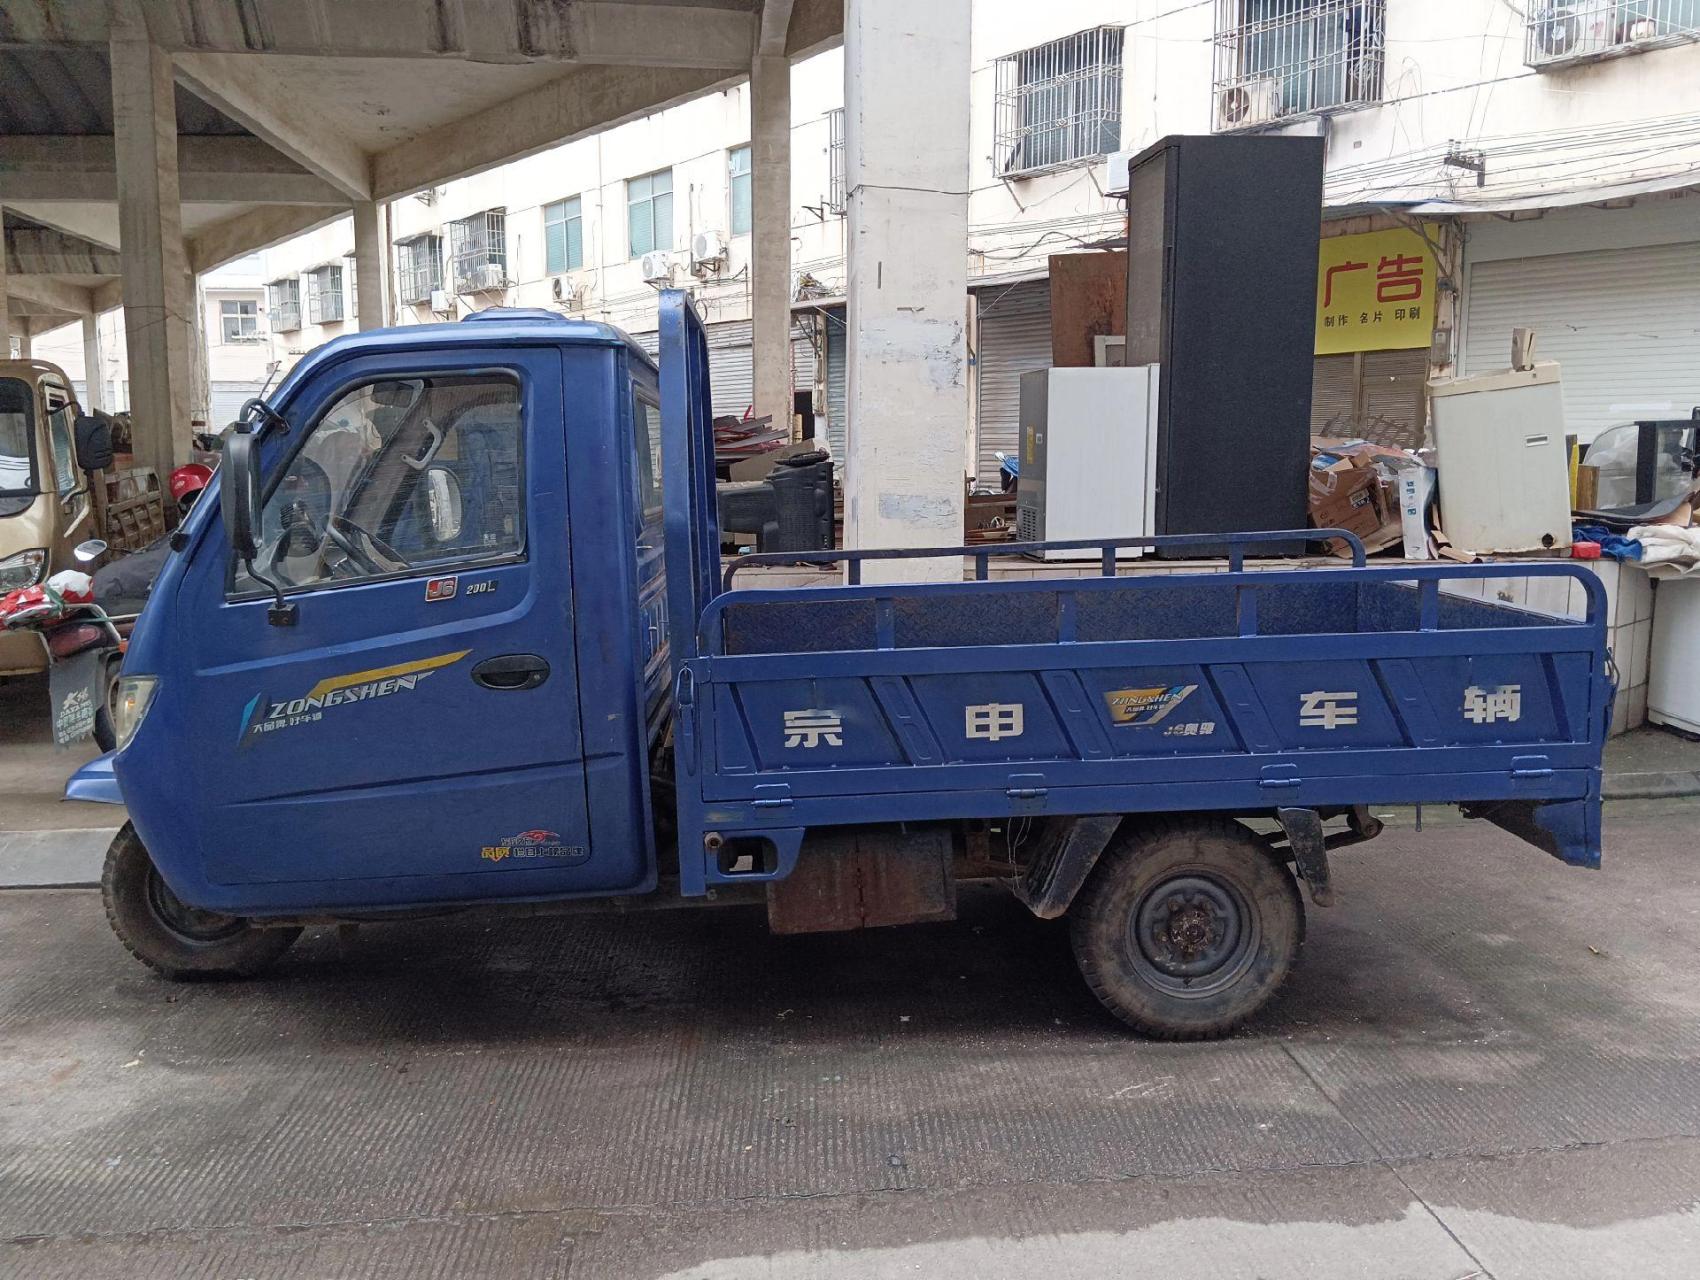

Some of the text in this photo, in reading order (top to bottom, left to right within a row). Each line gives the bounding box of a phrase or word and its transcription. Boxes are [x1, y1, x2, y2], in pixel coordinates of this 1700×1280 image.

[1324, 254, 1423, 308] 广告
[1325, 306, 1420, 327] 制作 名片 印刷
[269, 673, 418, 719] ZONGSHEN
[966, 703, 1024, 742] 申
[1300, 691, 1358, 729] 车
